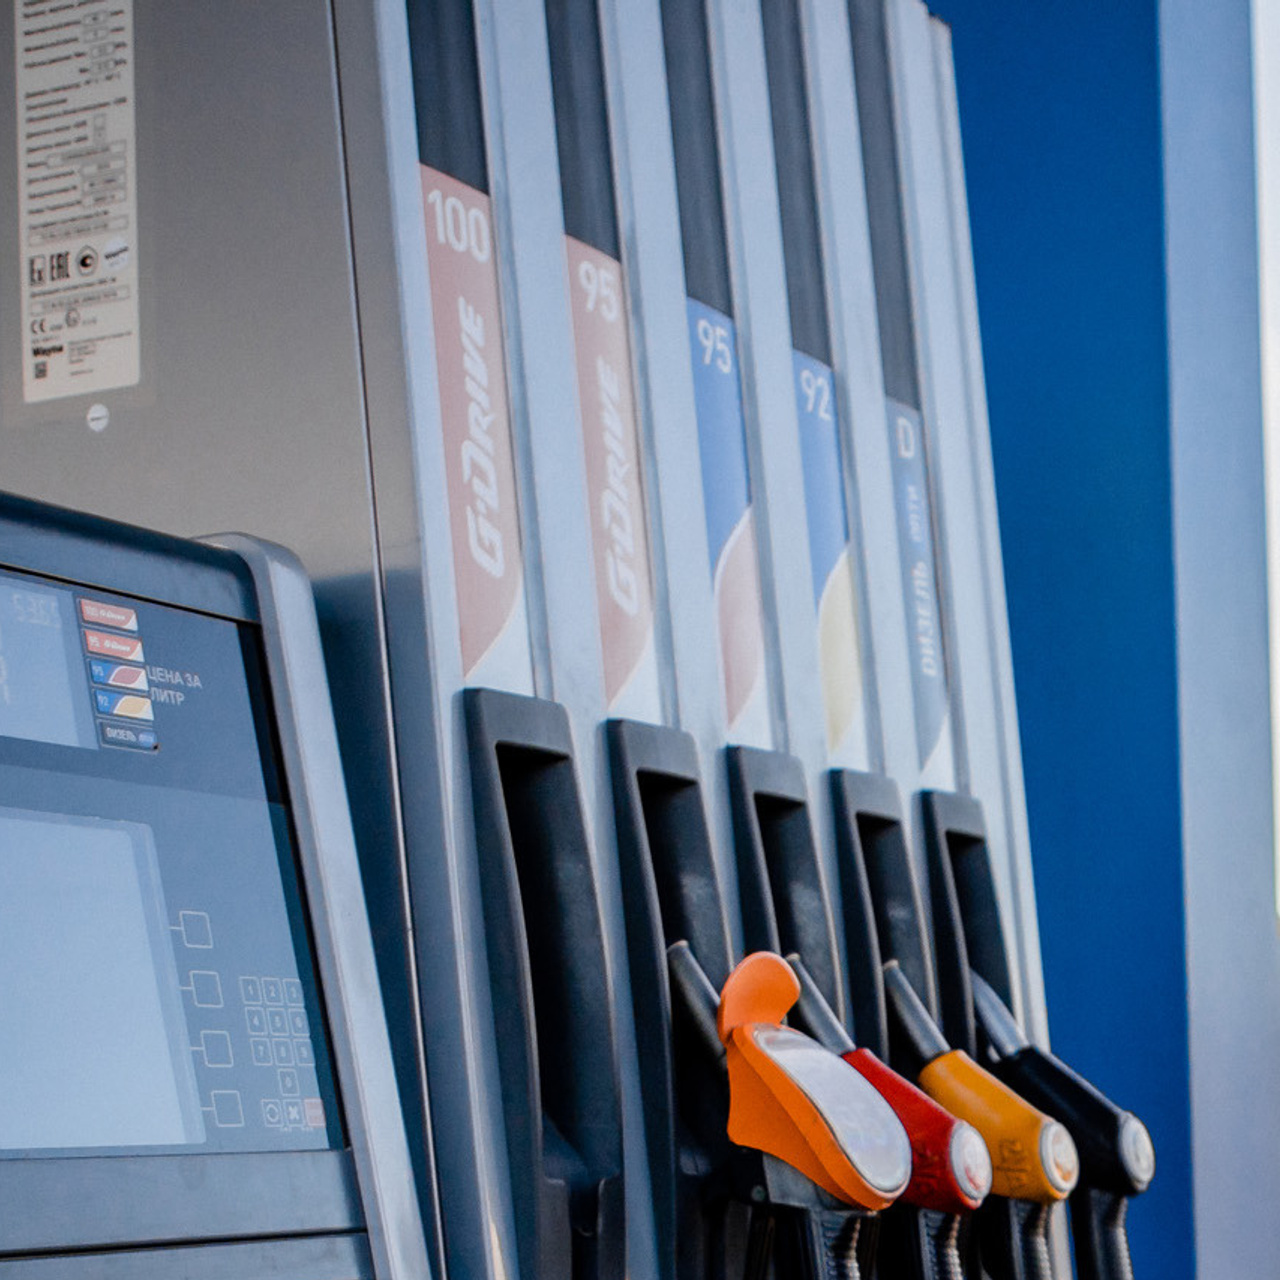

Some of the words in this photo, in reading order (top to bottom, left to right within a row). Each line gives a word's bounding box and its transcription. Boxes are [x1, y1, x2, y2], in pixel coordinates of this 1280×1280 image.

[427, 189, 490, 263] 100
[578, 261, 619, 322] 95
[697, 318, 732, 373] 95
[801, 369, 832, 421] 92
[146, 665, 184, 686] ЦЕНА
[184, 673, 203, 689] ЗА
[150, 686, 186, 706] ЛИТР
